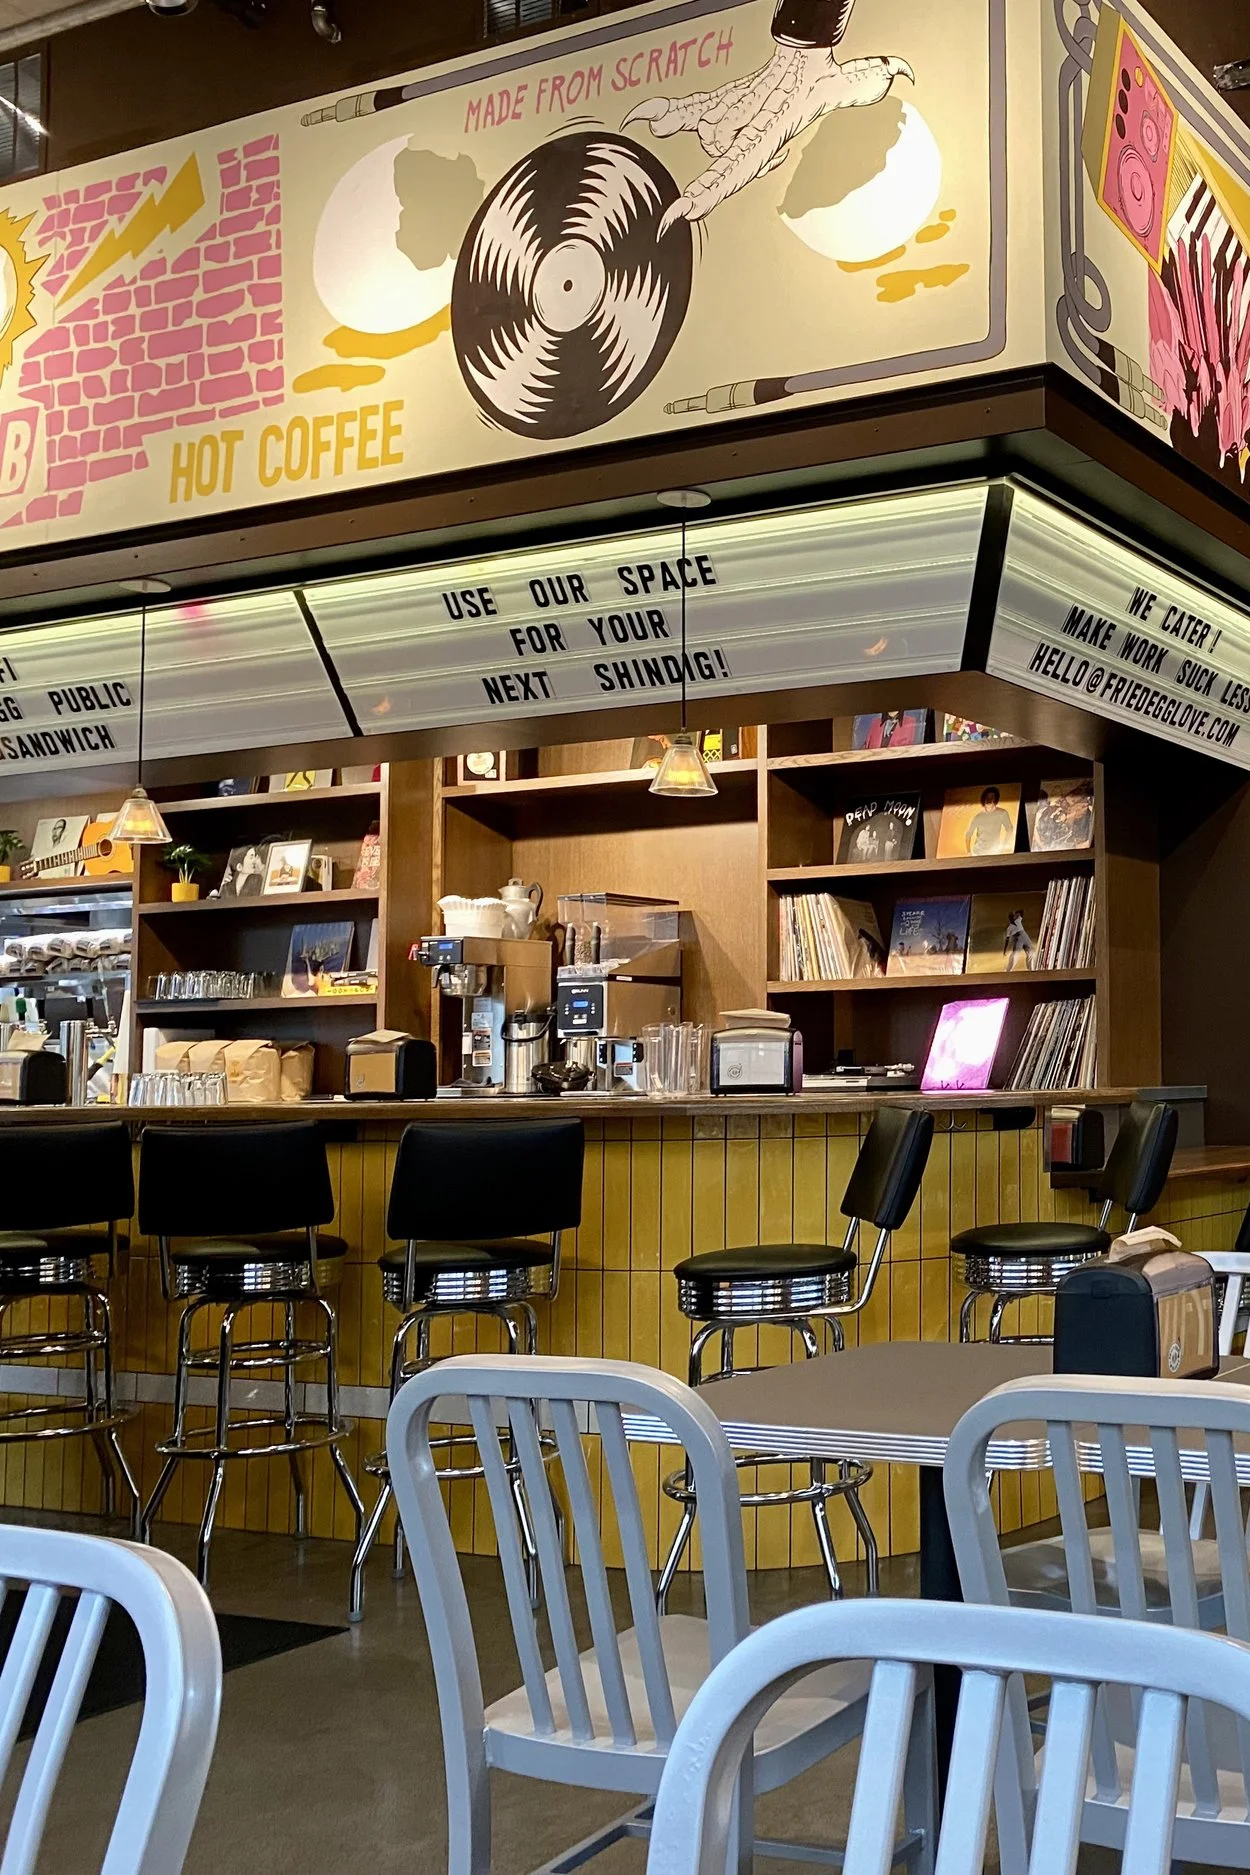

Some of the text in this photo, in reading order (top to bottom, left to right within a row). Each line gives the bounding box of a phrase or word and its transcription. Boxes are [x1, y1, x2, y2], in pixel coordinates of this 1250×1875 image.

[464, 26, 733, 133] MADE FROM SCRATCH
[169, 400, 404, 503] HOT COFFEE
[442, 554, 716, 620] USE OUR SPACE
[1129, 587, 1157, 621] WE
[509, 609, 670, 656] FOR YOUR
[1062, 606, 1117, 650] MAKE
[1120, 632, 1169, 674] WORK
[1176, 659, 1218, 696] SUCK
[48, 682, 131, 715] PUBLIC
[482, 649, 729, 704] NEXT SHINDIG!
[1029, 642, 1240, 747] HELLO@FRIEDEGGLOVE.COM
[0, 725, 115, 760] SANDWICH
[846, 802, 877, 827] DEAD
